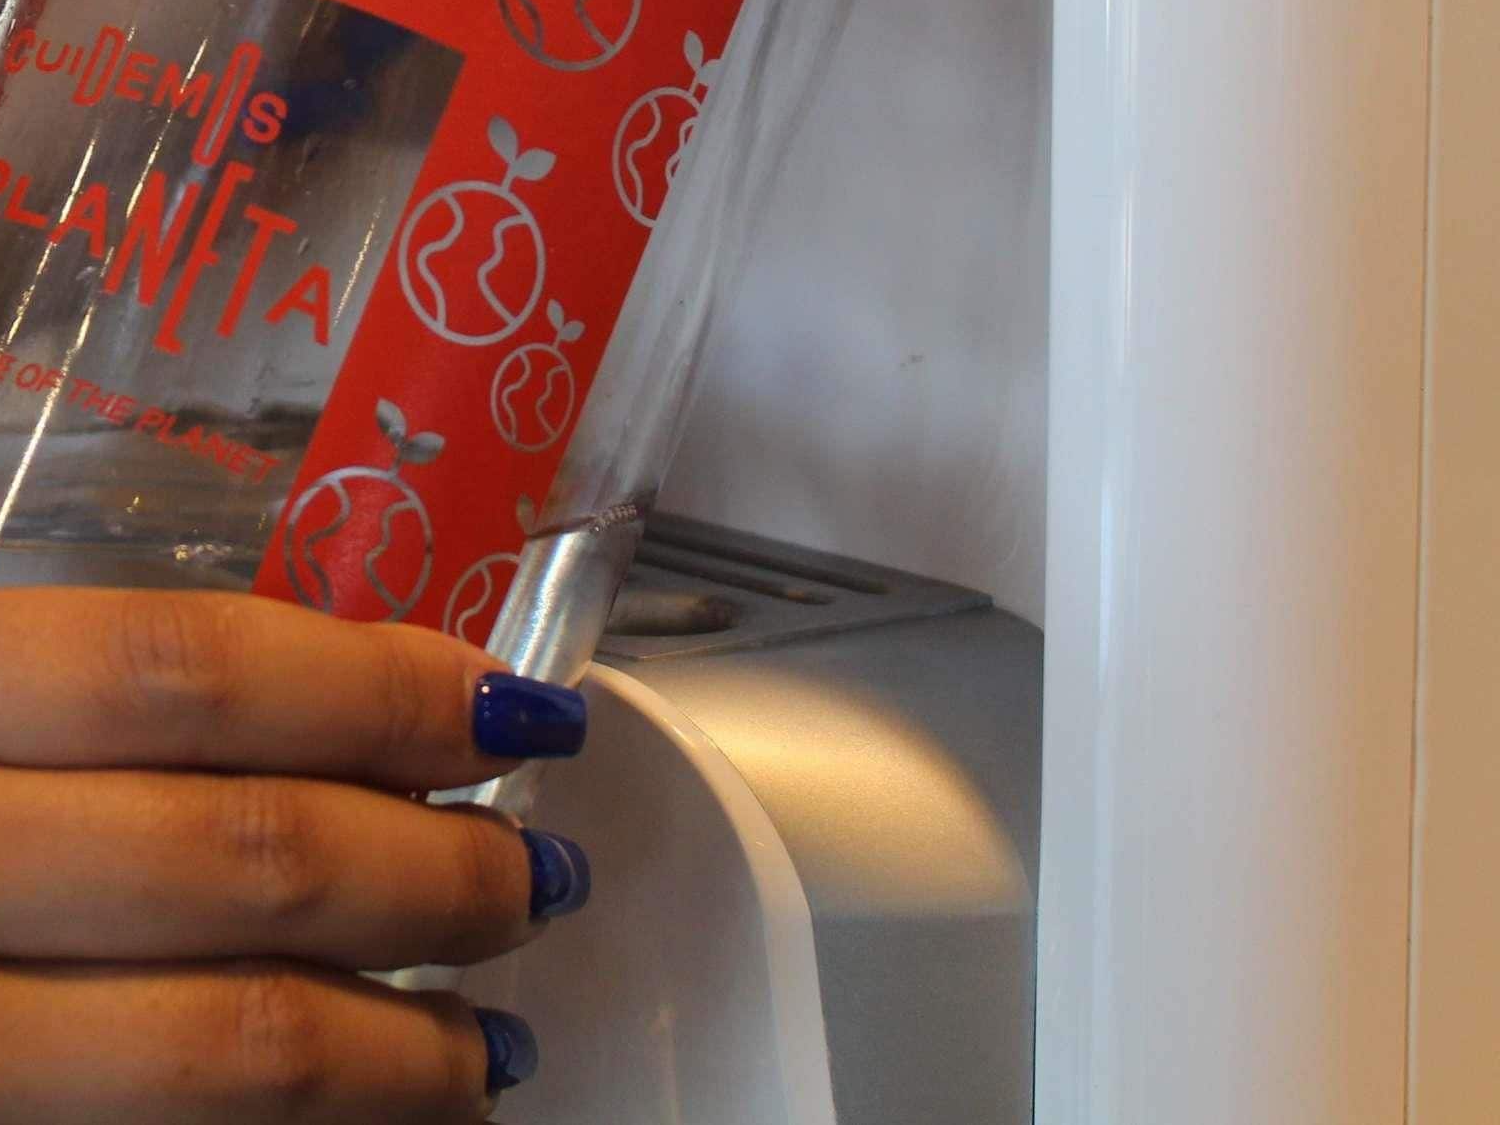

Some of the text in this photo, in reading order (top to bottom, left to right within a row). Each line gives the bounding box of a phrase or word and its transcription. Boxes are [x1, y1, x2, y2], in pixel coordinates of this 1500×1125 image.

[4, 21, 288, 167] CUIDEMOS
[15, 363, 64, 393] OF
[68, 378, 138, 425] THE
[135, 405, 281, 485] PLANET
